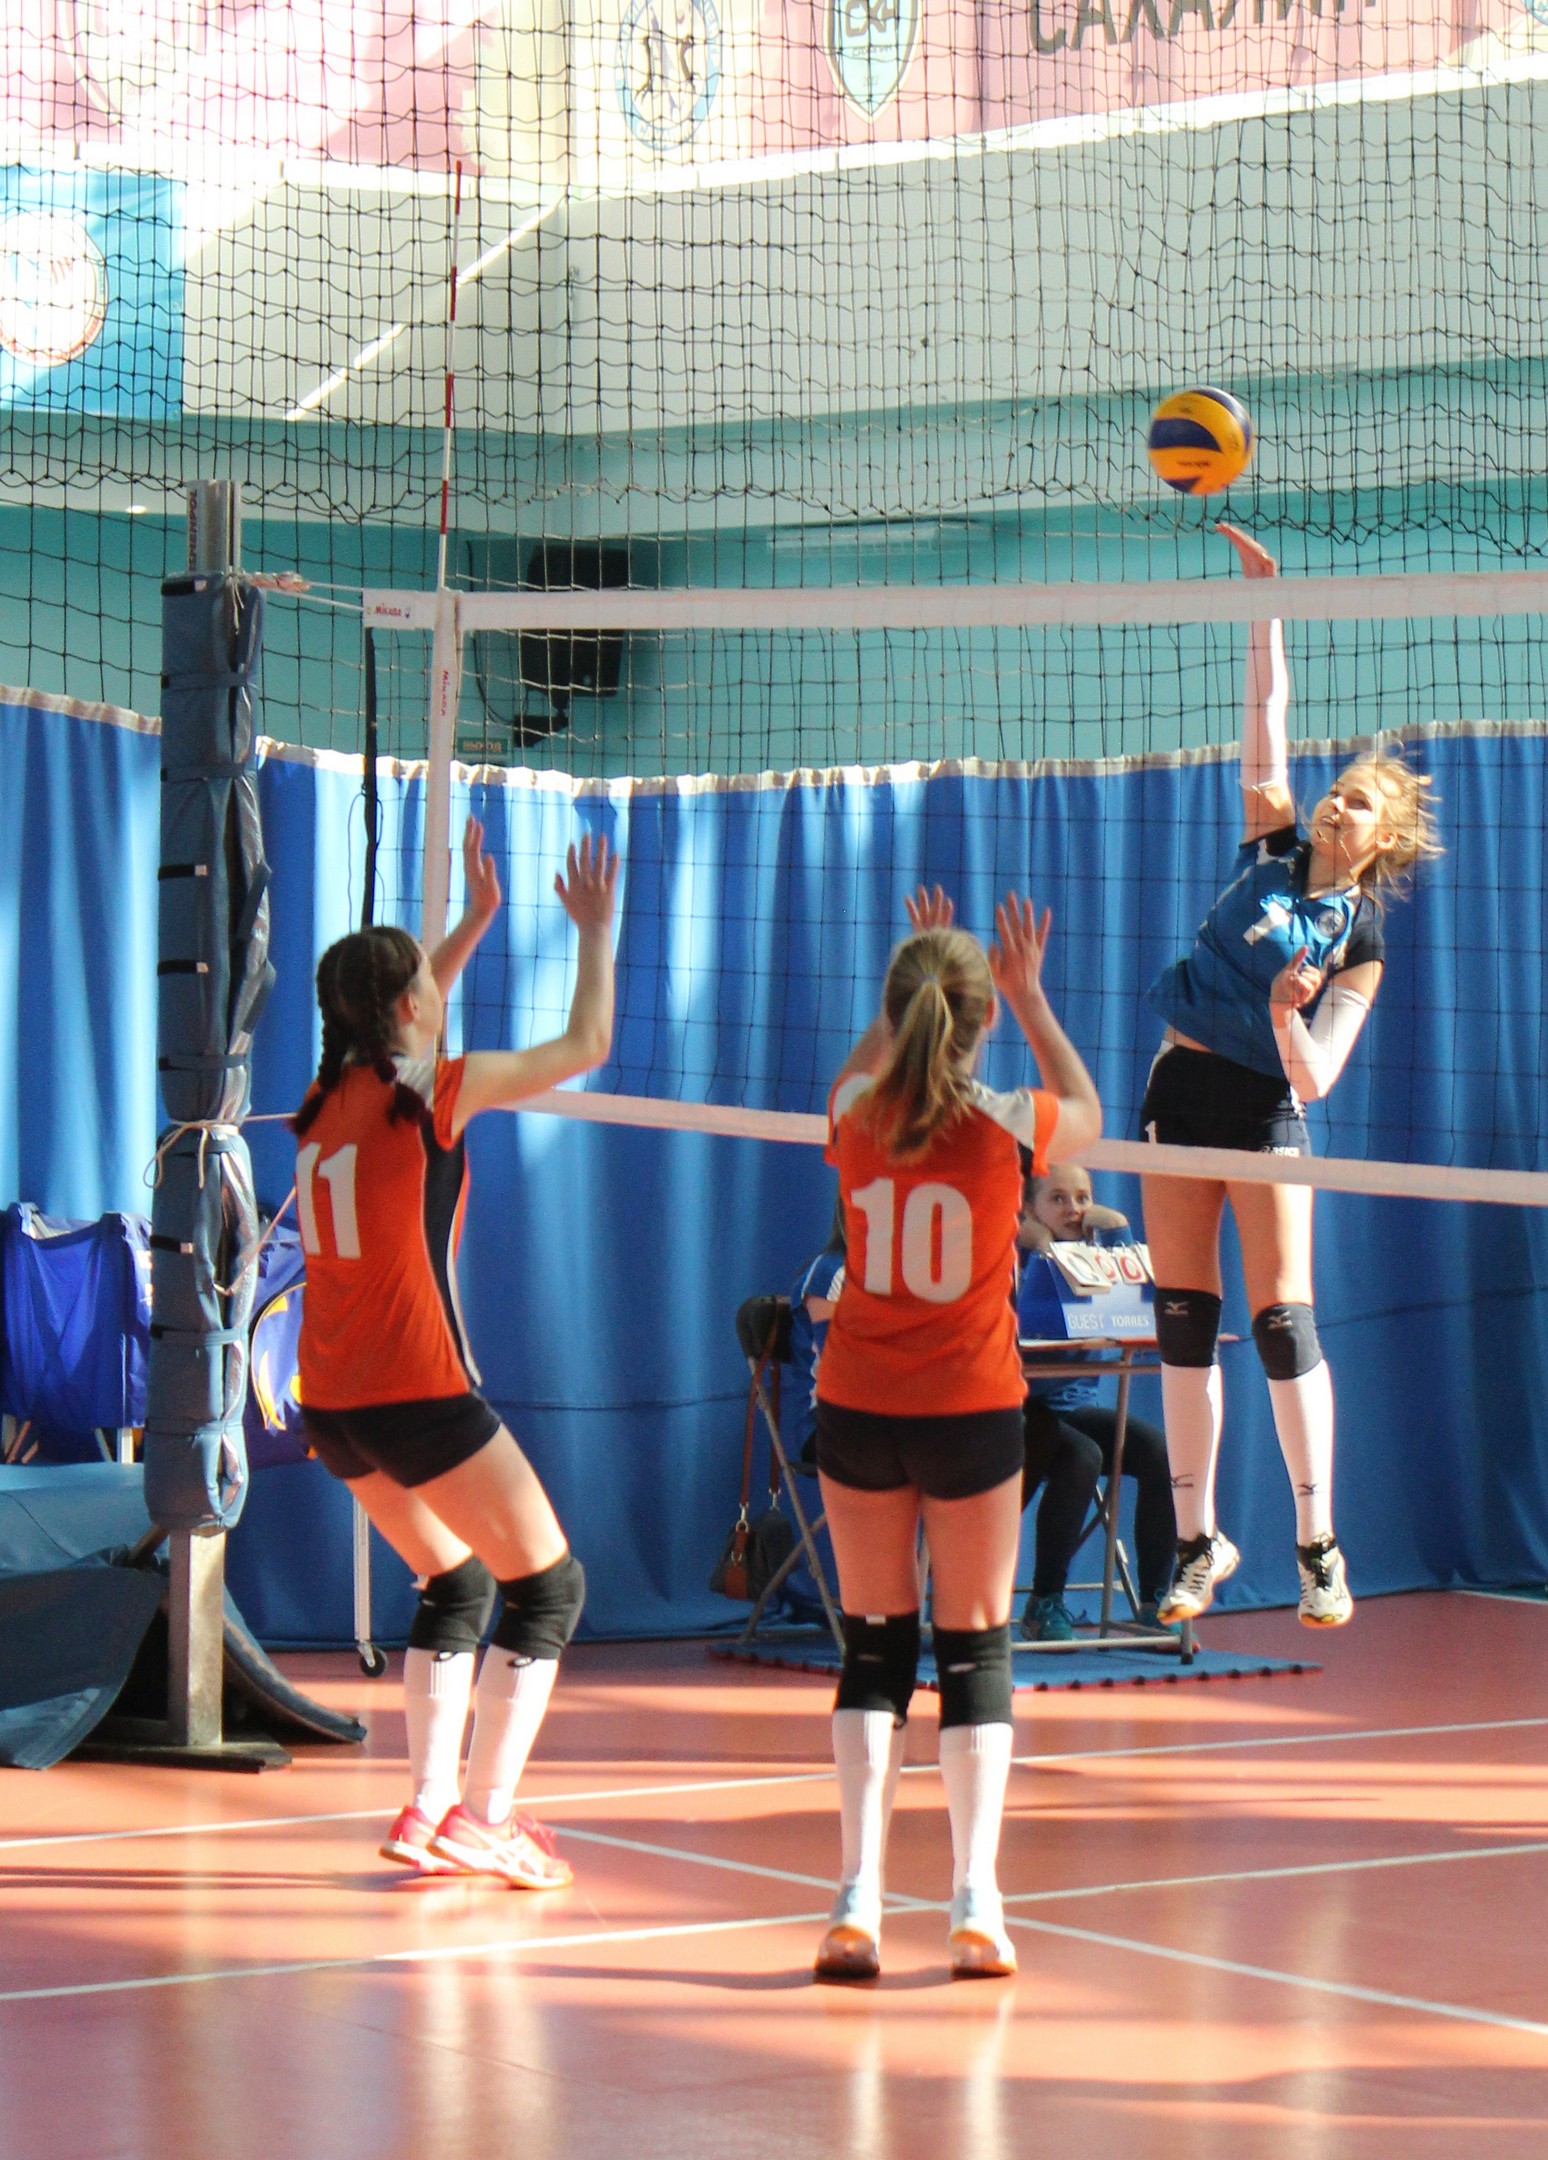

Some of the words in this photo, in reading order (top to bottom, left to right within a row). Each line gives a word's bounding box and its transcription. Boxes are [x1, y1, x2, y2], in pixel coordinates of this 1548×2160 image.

[296, 1141, 361, 1260] 11
[851, 1177, 973, 1304] 10
[1067, 1313, 1104, 1329] GUEST
[1112, 1315, 1149, 1328] TORRES
